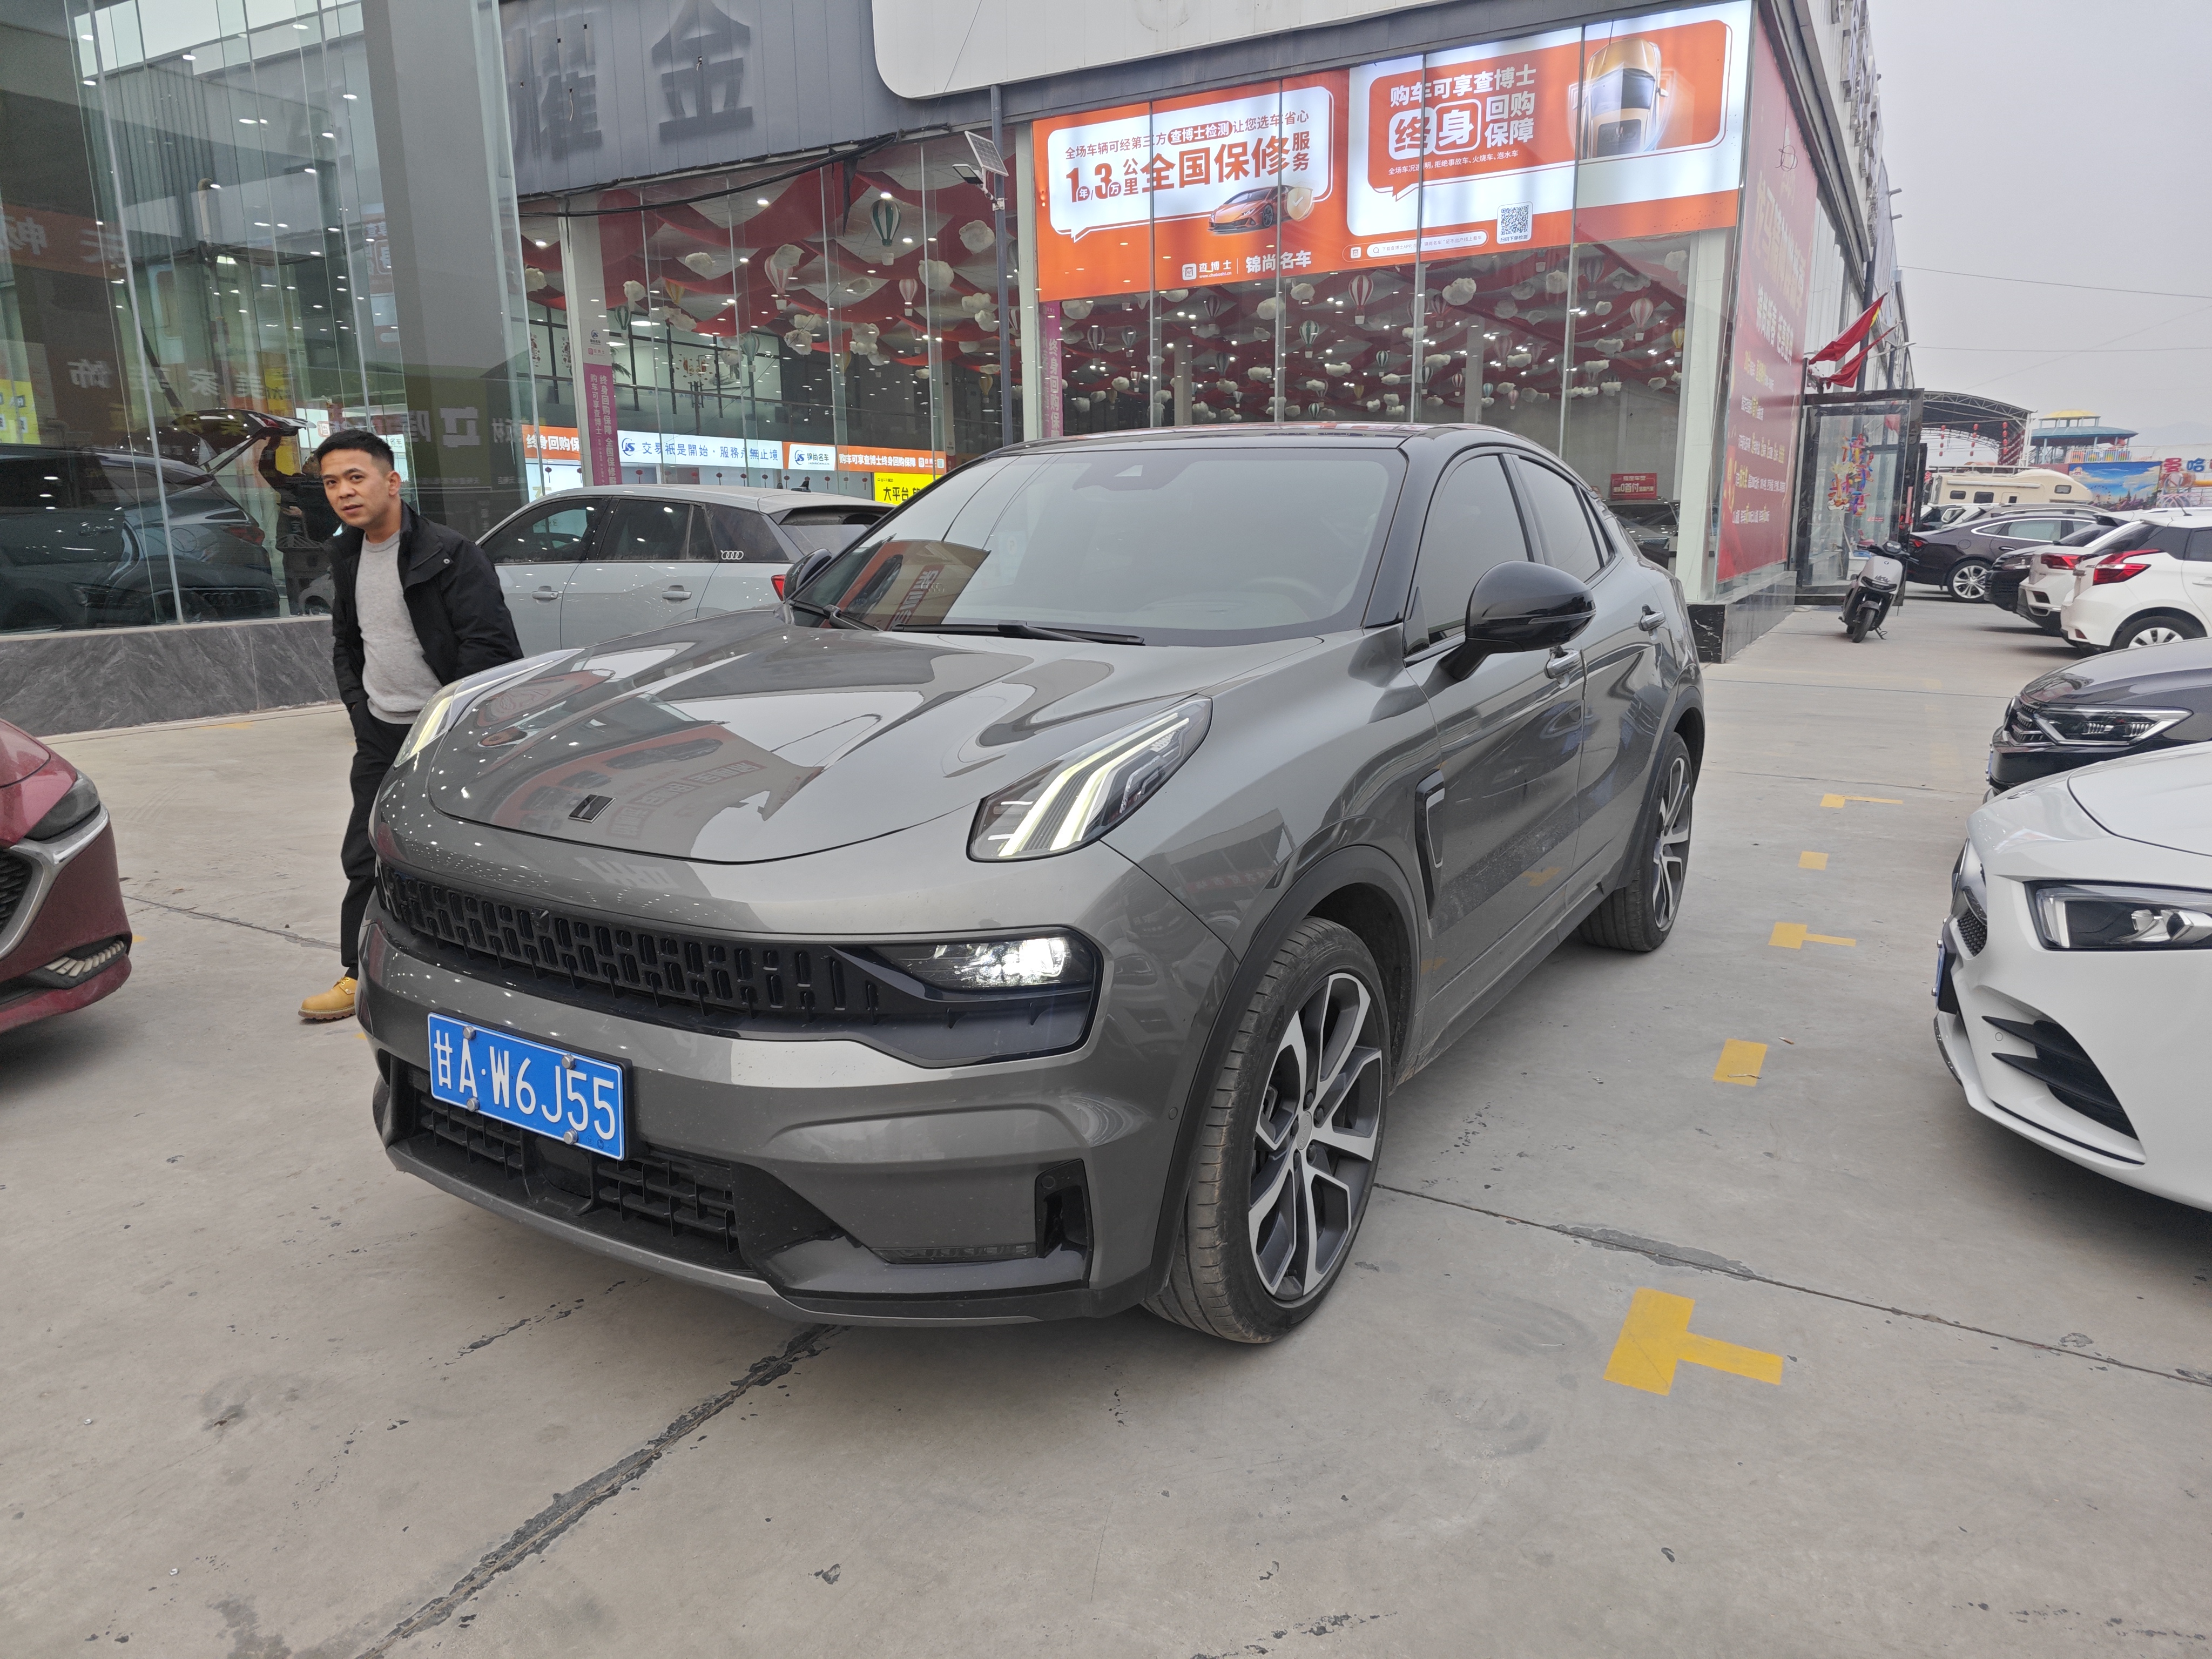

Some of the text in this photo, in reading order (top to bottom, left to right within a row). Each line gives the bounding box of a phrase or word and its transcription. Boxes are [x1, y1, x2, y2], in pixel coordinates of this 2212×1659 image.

[1390, 64, 1536, 107] 购车可享查博士
[1486, 91, 1535, 122] 回购
[1392, 107, 1474, 154] 终身
[1485, 119, 1534, 149] 保障
[1199, 260, 1232, 273] 查博士
[1245, 250, 1312, 274] 锦尚名车
[807, 453, 830, 462] 锦尚名车
[883, 487, 909, 501] 大平台
